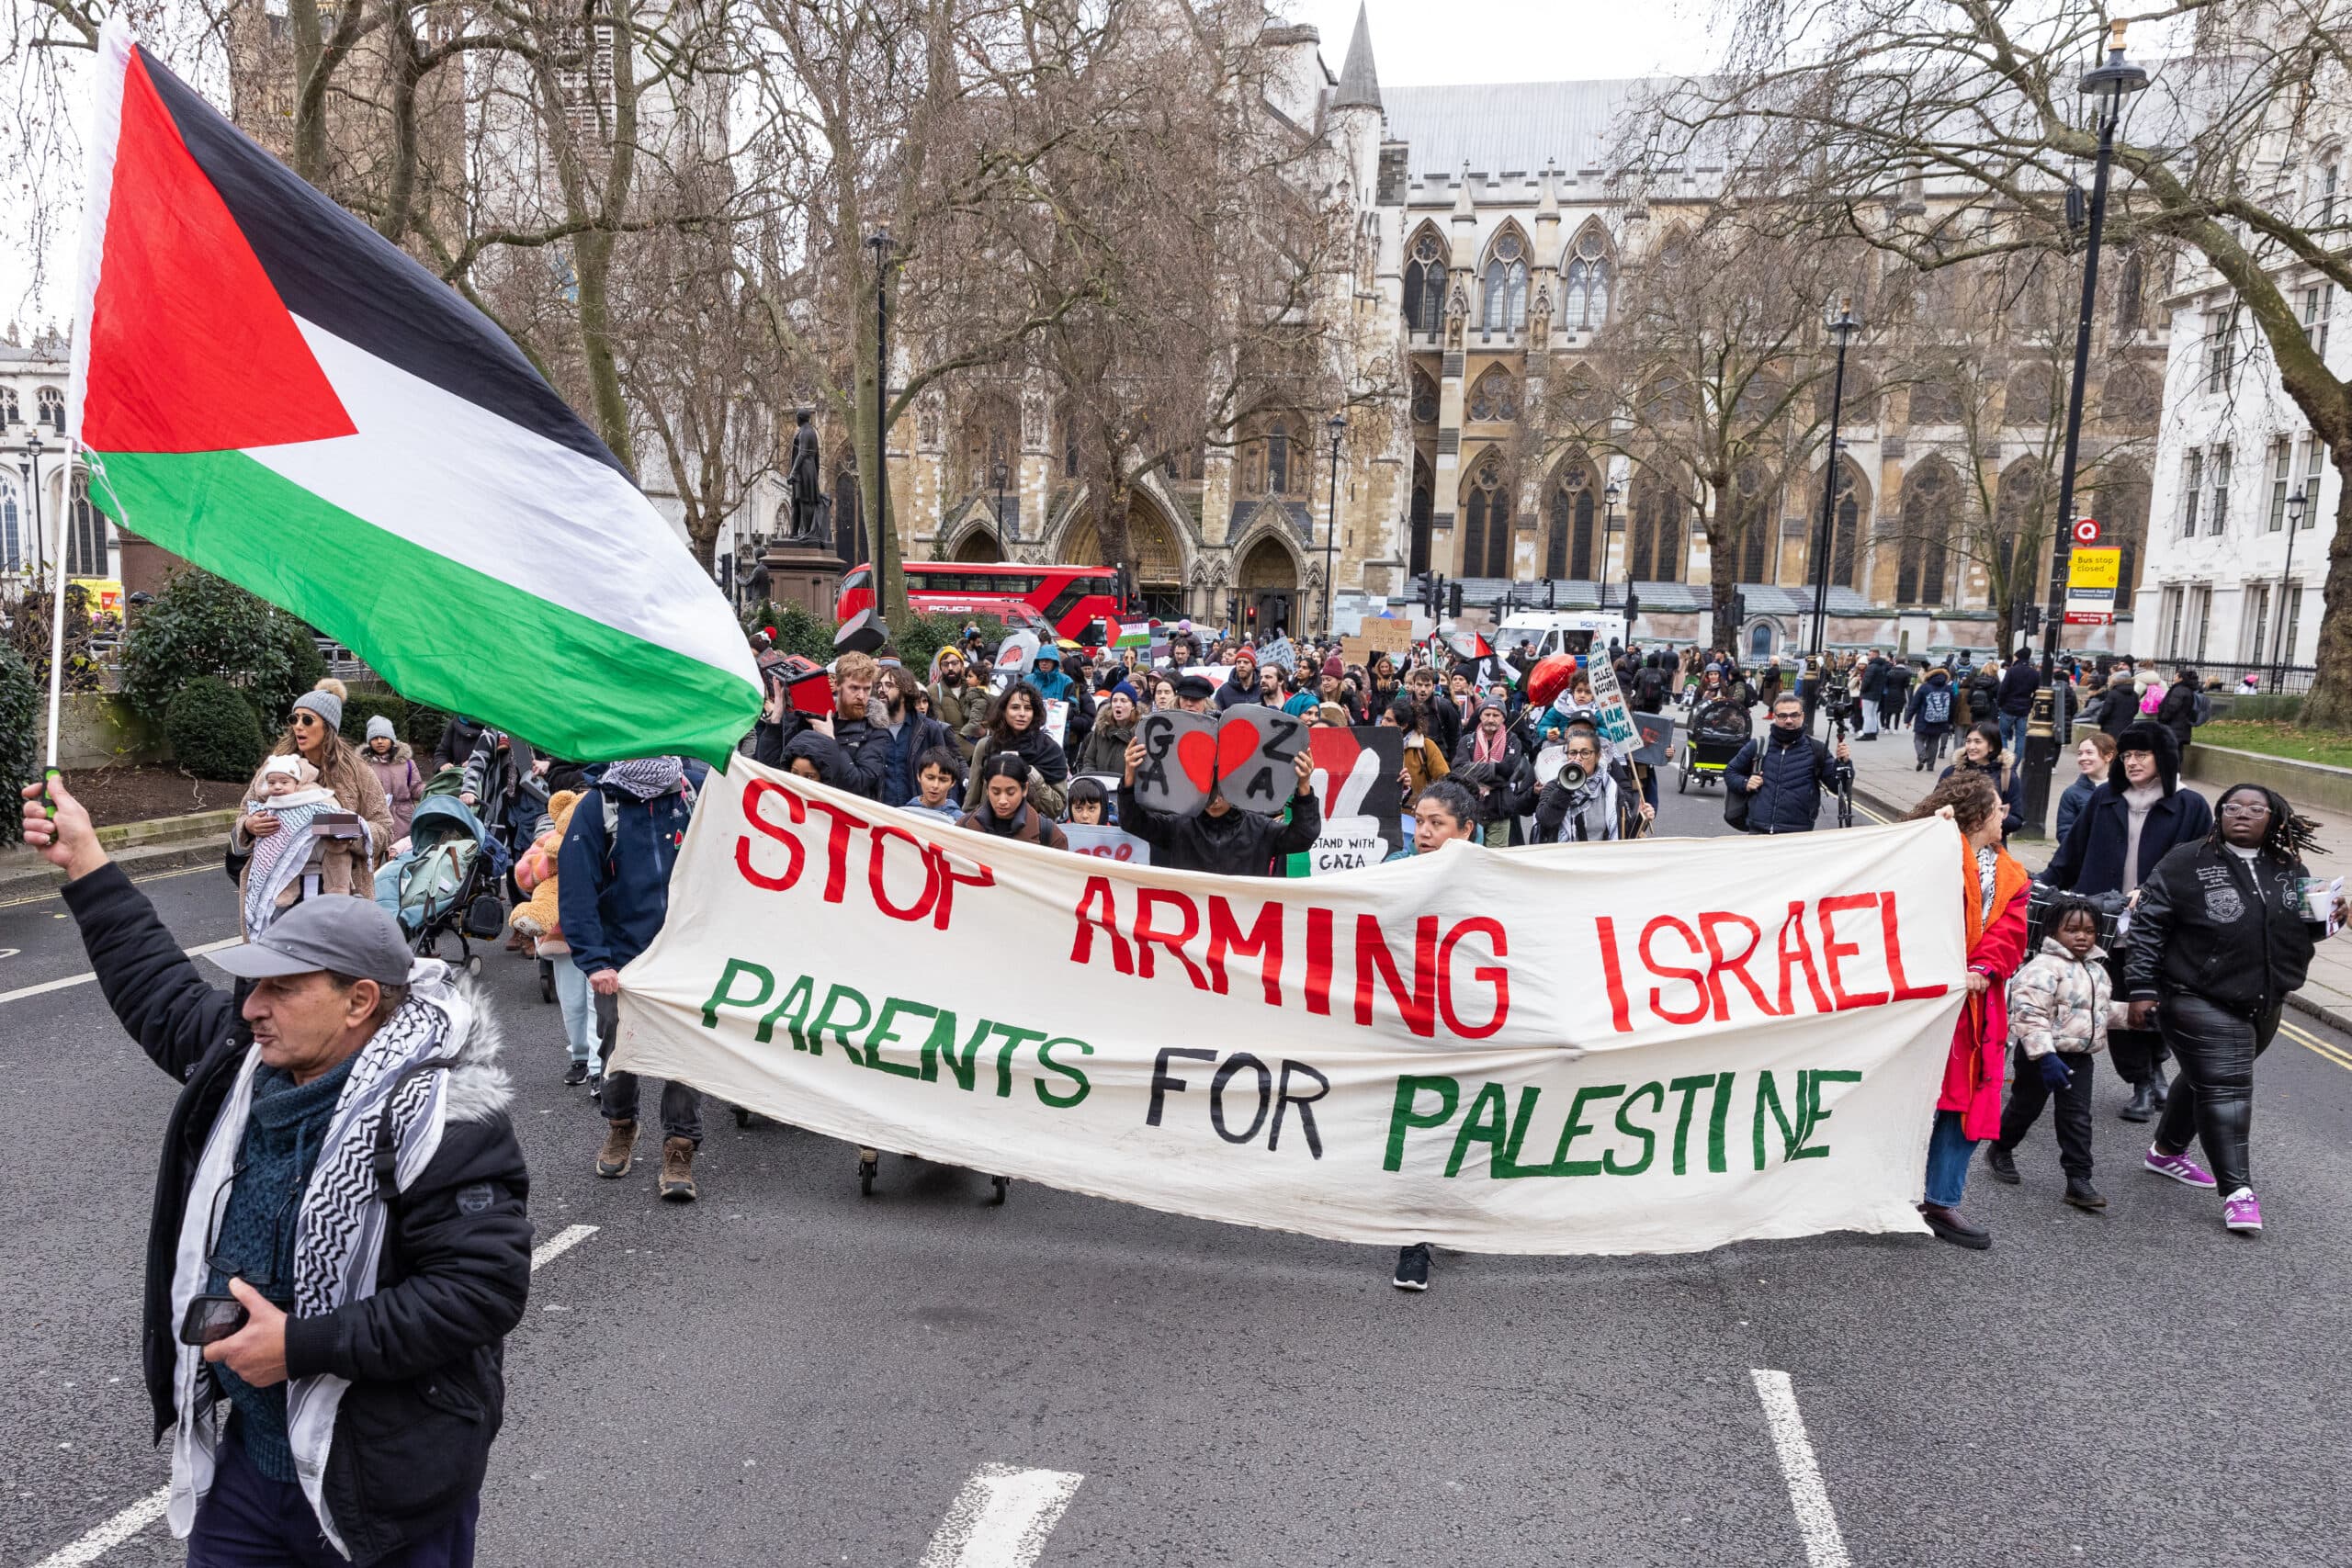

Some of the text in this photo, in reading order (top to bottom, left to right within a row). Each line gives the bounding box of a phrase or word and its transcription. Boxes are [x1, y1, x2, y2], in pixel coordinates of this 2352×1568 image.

[2077, 523, 2097, 539] Q
[2096, 557, 2114, 566] stop
[1348, 838, 1375, 849] WITH
[1319, 853, 1365, 870] GAZA
[735, 778, 1948, 1039] STOP ARMING ISRAEL
[701, 957, 1862, 1179] PARENTS FOR PALESTINE
